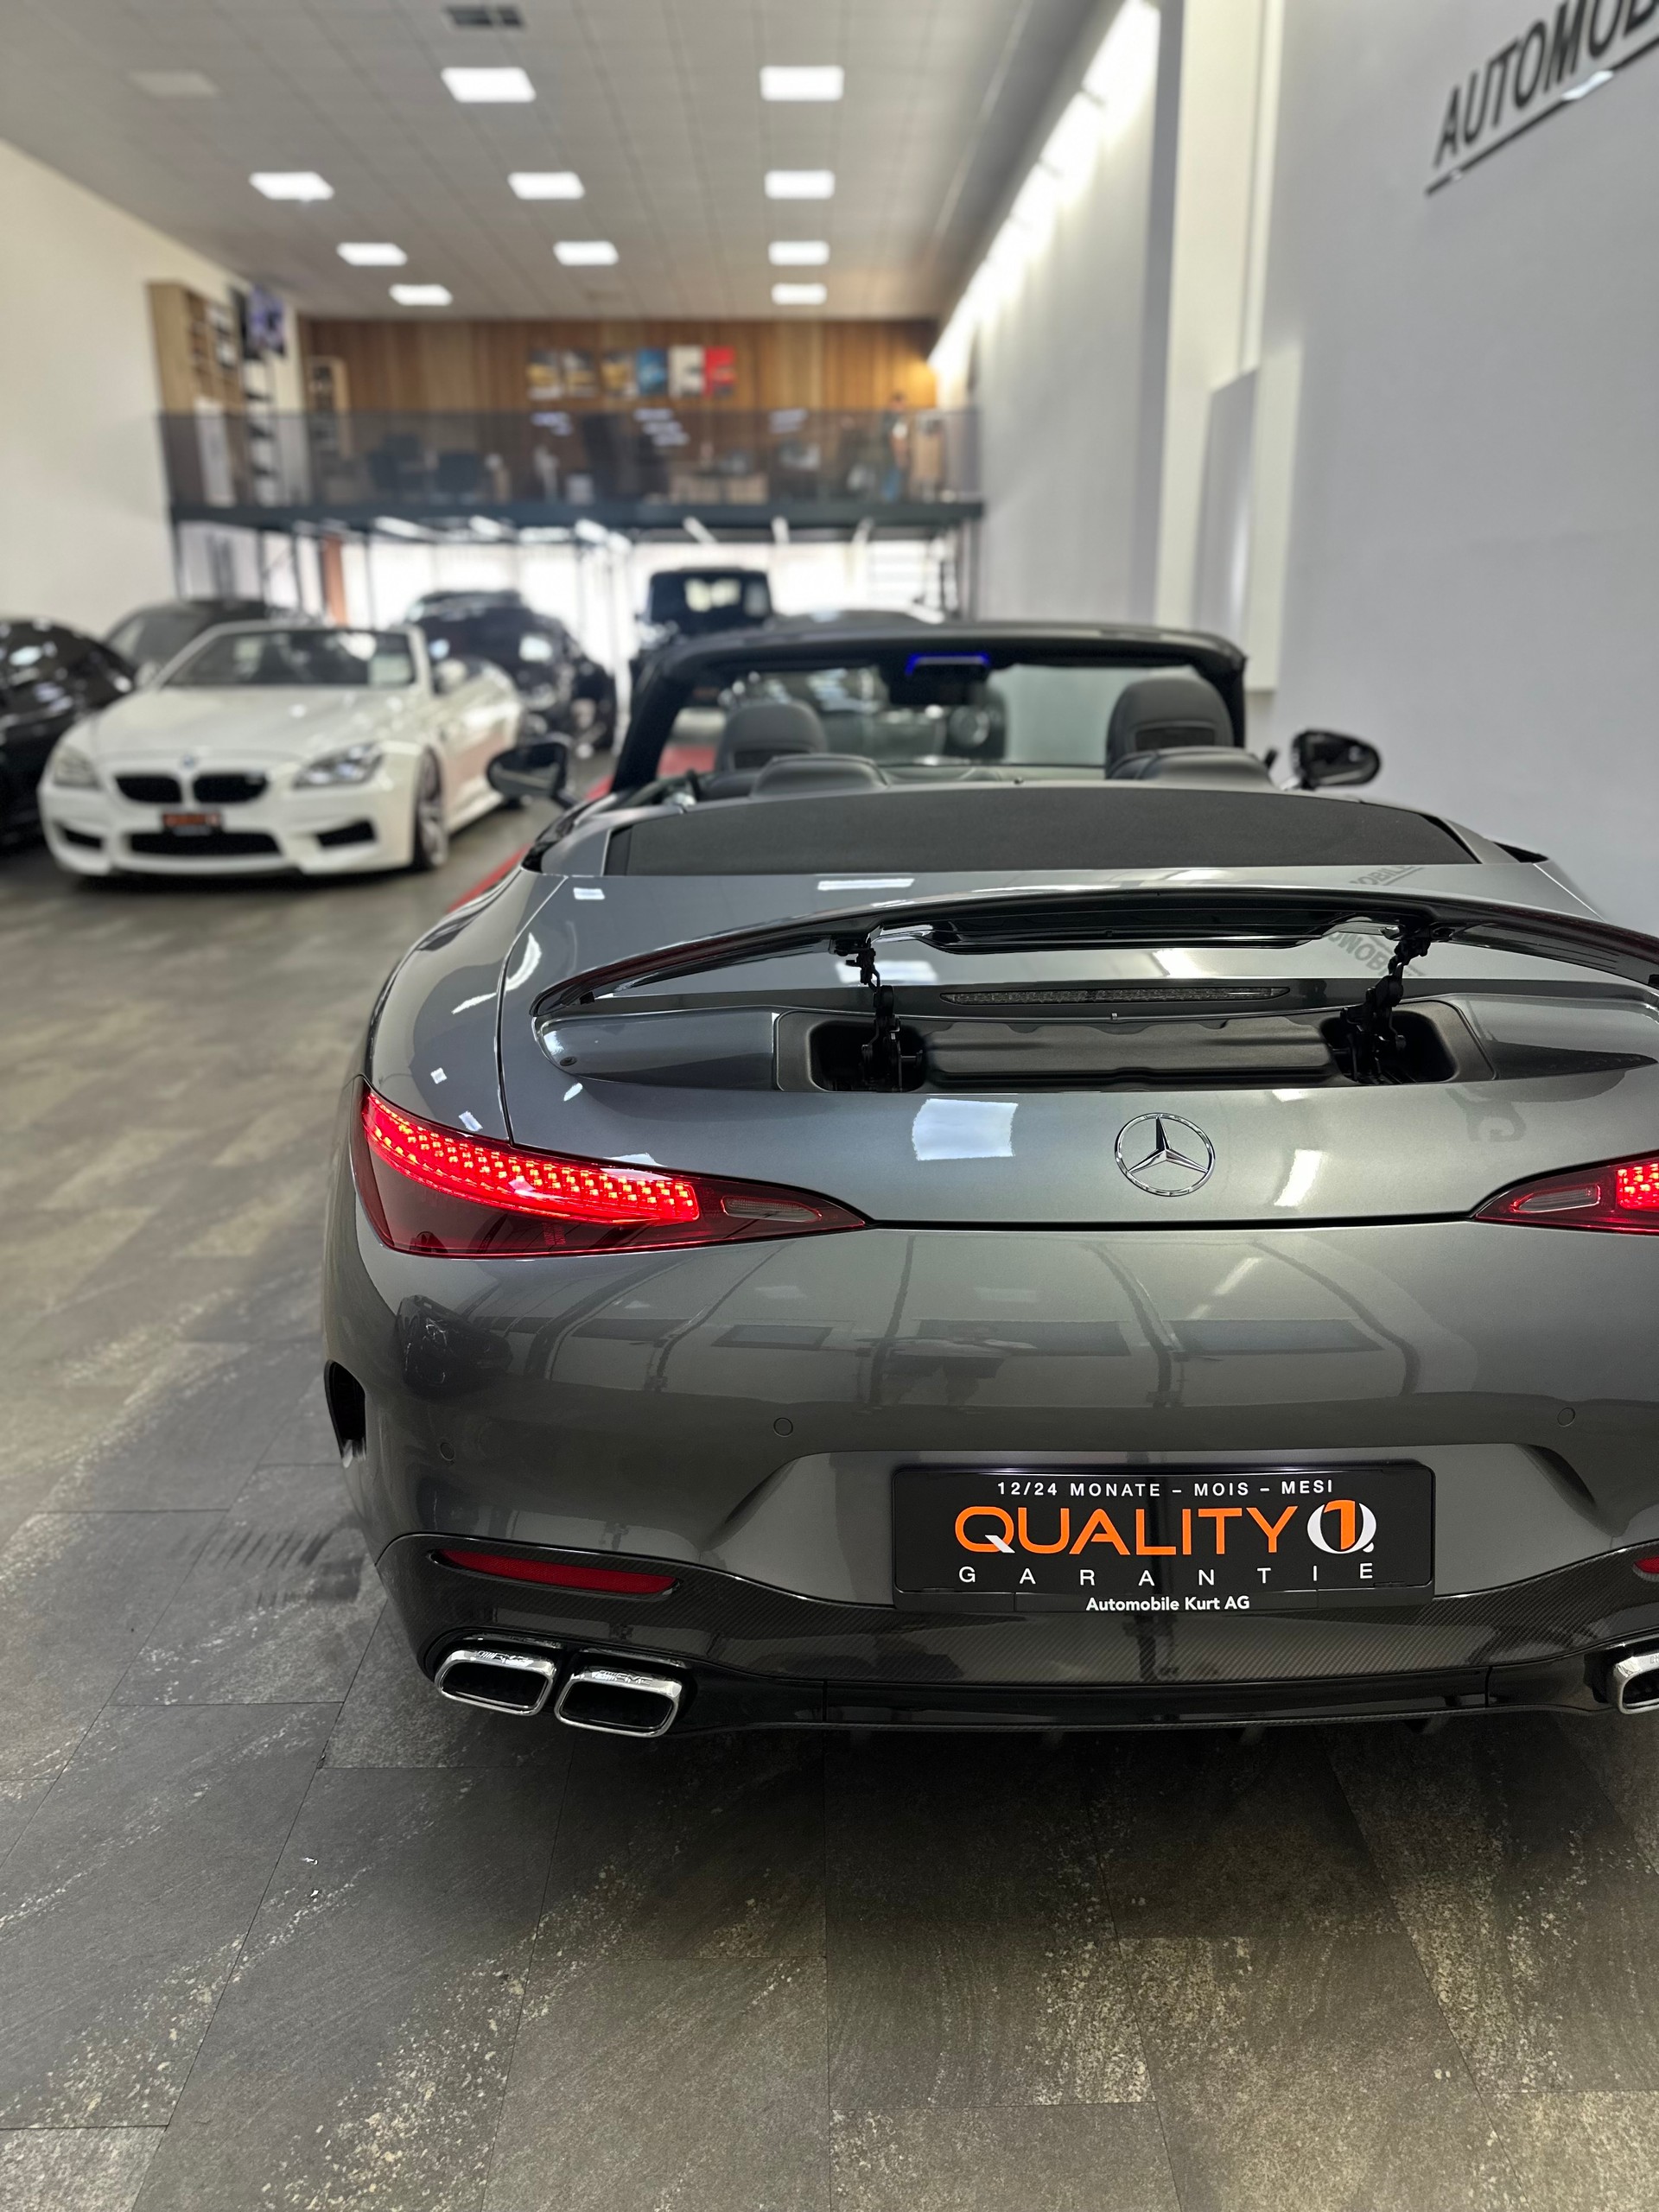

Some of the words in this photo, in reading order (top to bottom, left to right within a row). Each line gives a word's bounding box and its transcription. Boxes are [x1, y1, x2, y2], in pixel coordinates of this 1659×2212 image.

[997, 1481, 1058, 1497] 12/24
[1070, 1483, 1160, 1497] MONATE
[1194, 1482, 1249, 1497] MOIS
[1281, 1479, 1332, 1495] MESI
[955, 1505, 1299, 1555] QUALITY
[958, 1562, 1373, 1586] GARANTIE
[1085, 1597, 1180, 1611] Automobile
[1185, 1597, 1221, 1611] Kurt
[1224, 1596, 1250, 1610] AG
